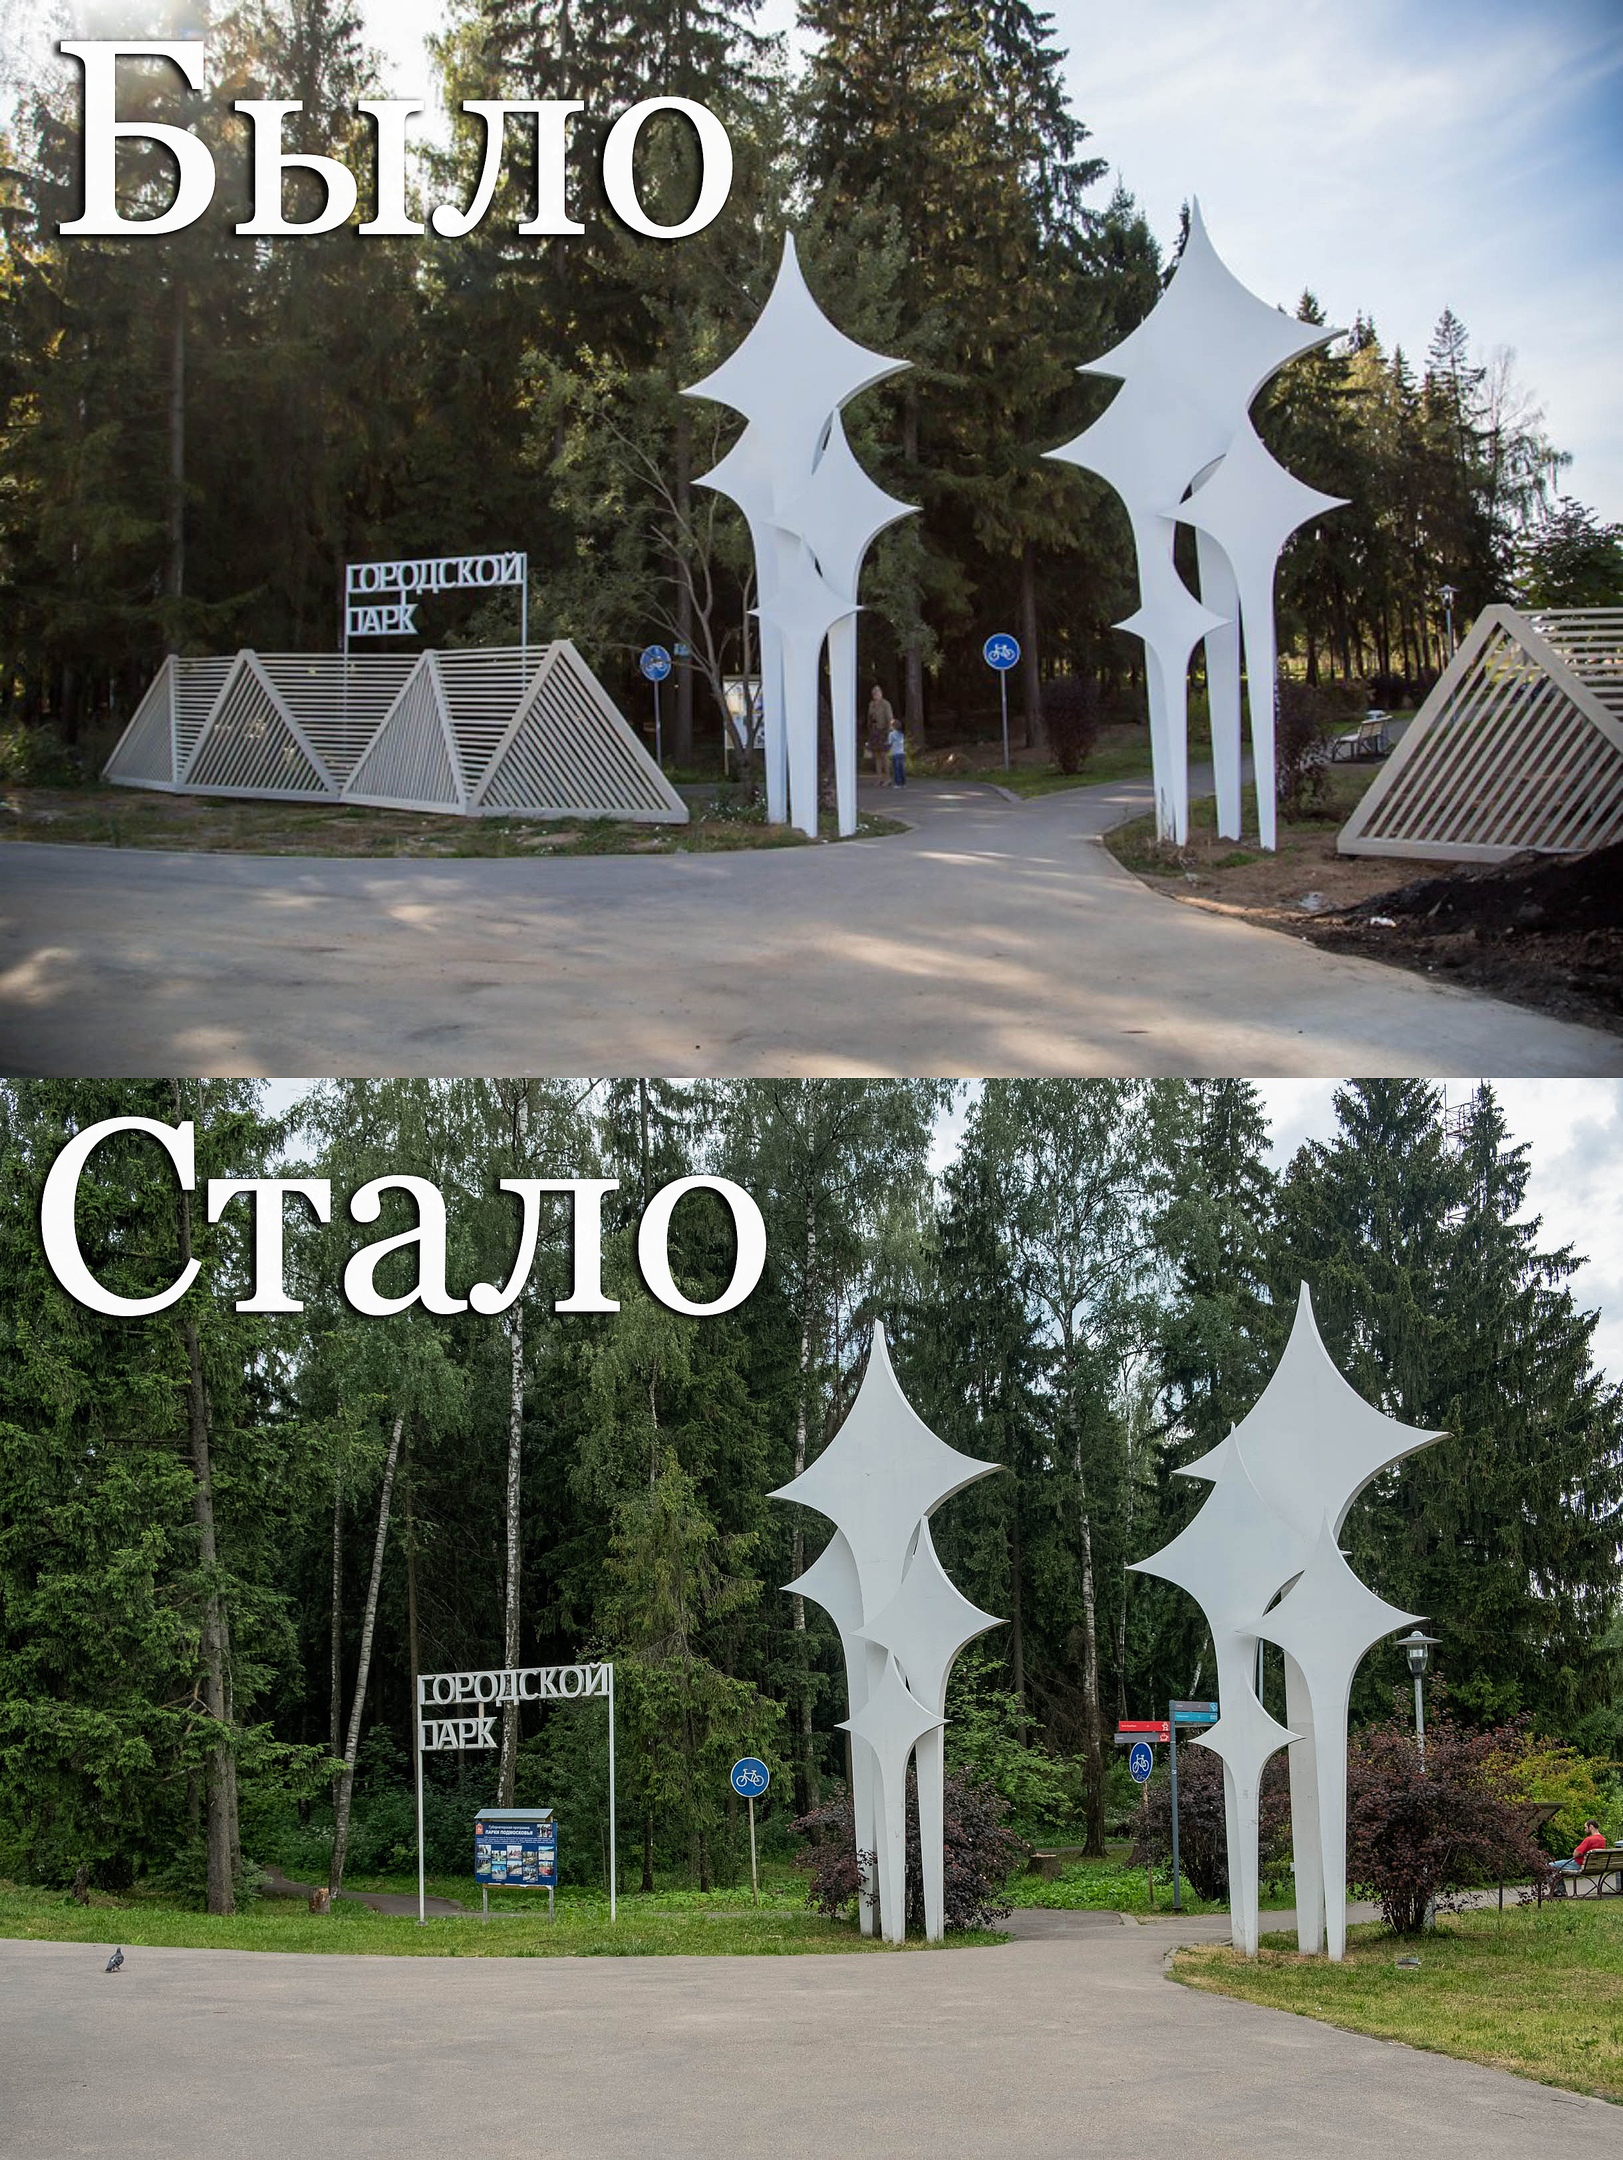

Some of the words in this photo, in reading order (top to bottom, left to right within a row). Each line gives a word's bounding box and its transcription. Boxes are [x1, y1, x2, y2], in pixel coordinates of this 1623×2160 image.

[347, 552, 523, 595] ГОРОДСКОЙ
[347, 604, 419, 636] ПАРК
[420, 1662, 610, 1706] ГОРОДСКОЙ
[419, 1717, 499, 1750] ПАРК
